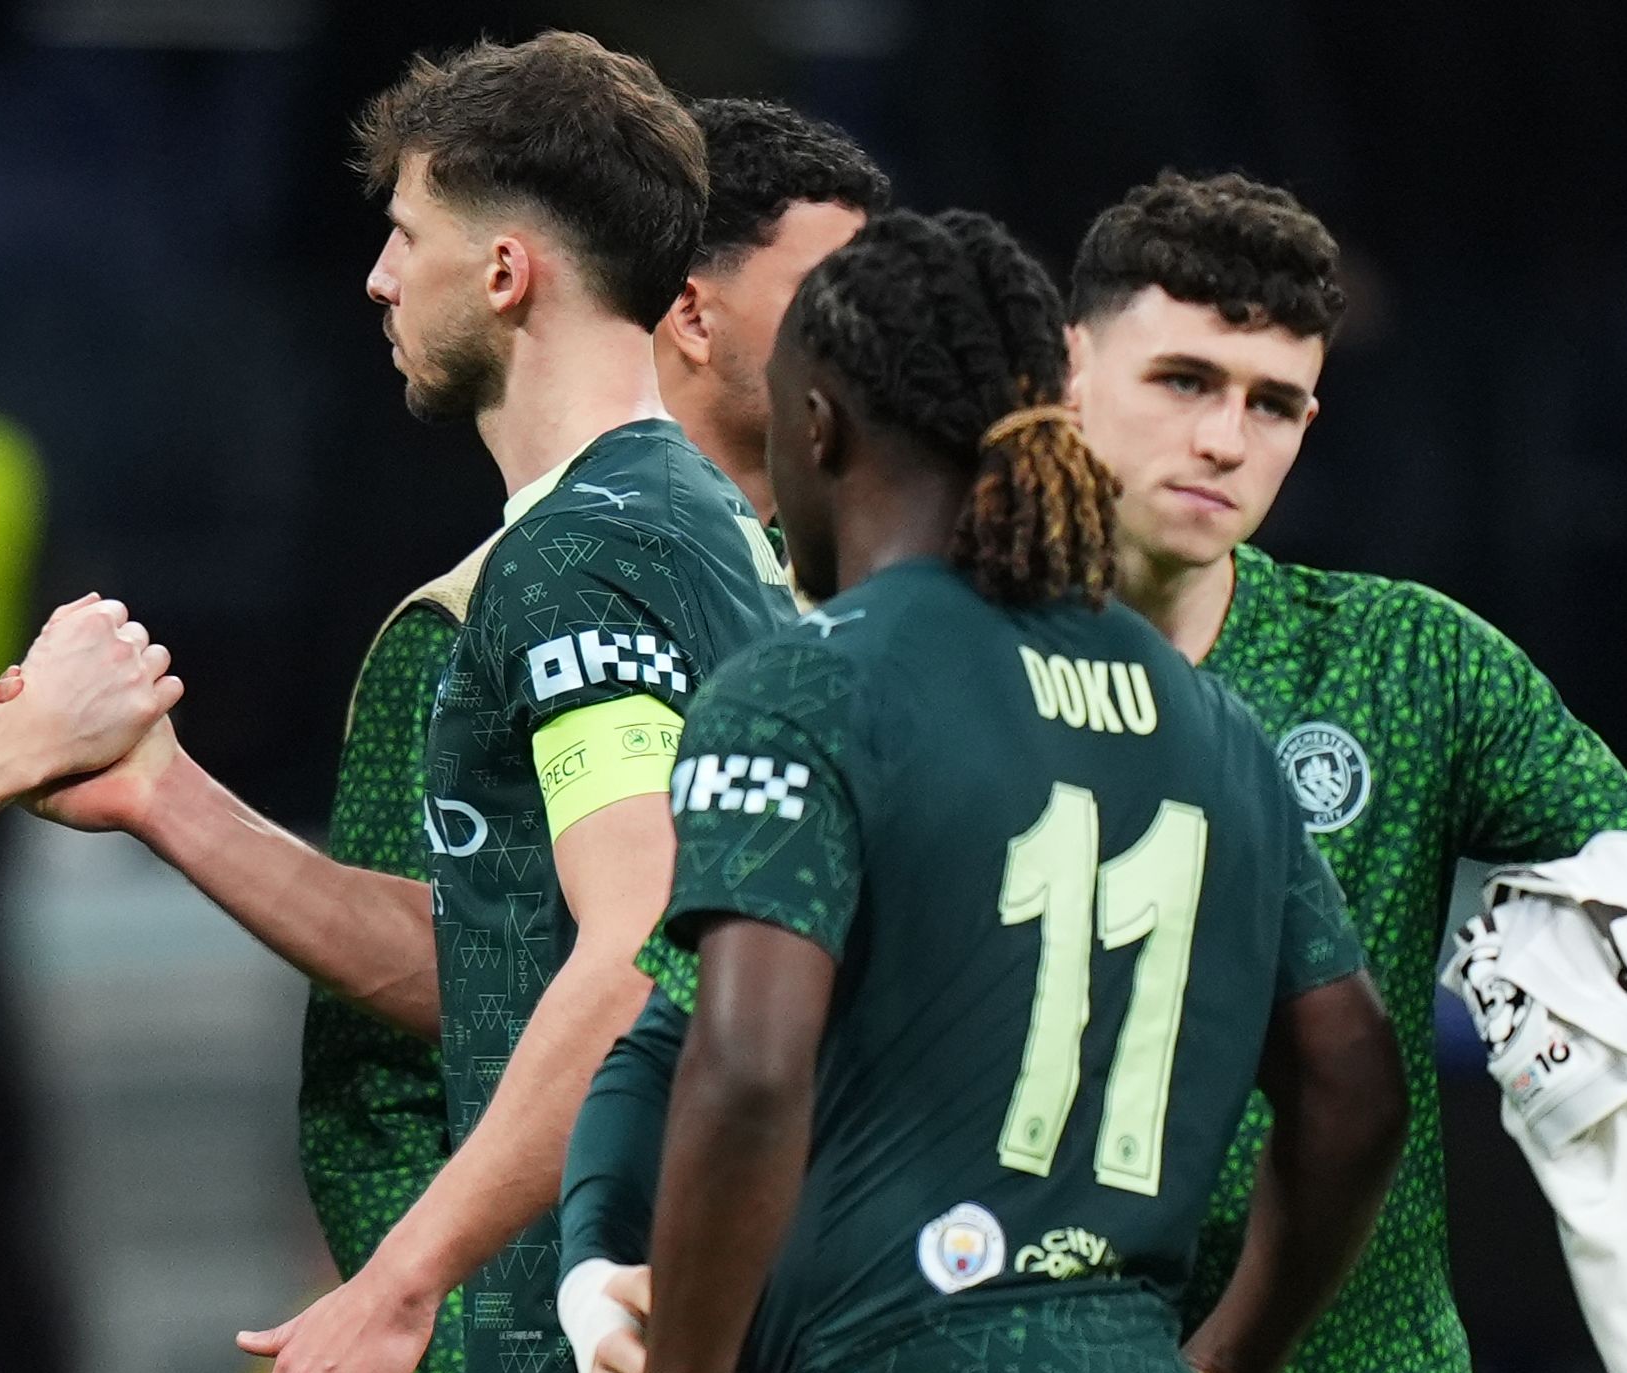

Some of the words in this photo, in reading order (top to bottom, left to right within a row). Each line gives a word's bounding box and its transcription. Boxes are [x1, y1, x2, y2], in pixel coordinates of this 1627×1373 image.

[528, 630, 688, 702] OKX
[1017, 645, 1158, 736] DOKU
[542, 748, 587, 800] SPECT
[997, 780, 1209, 1198] 11
